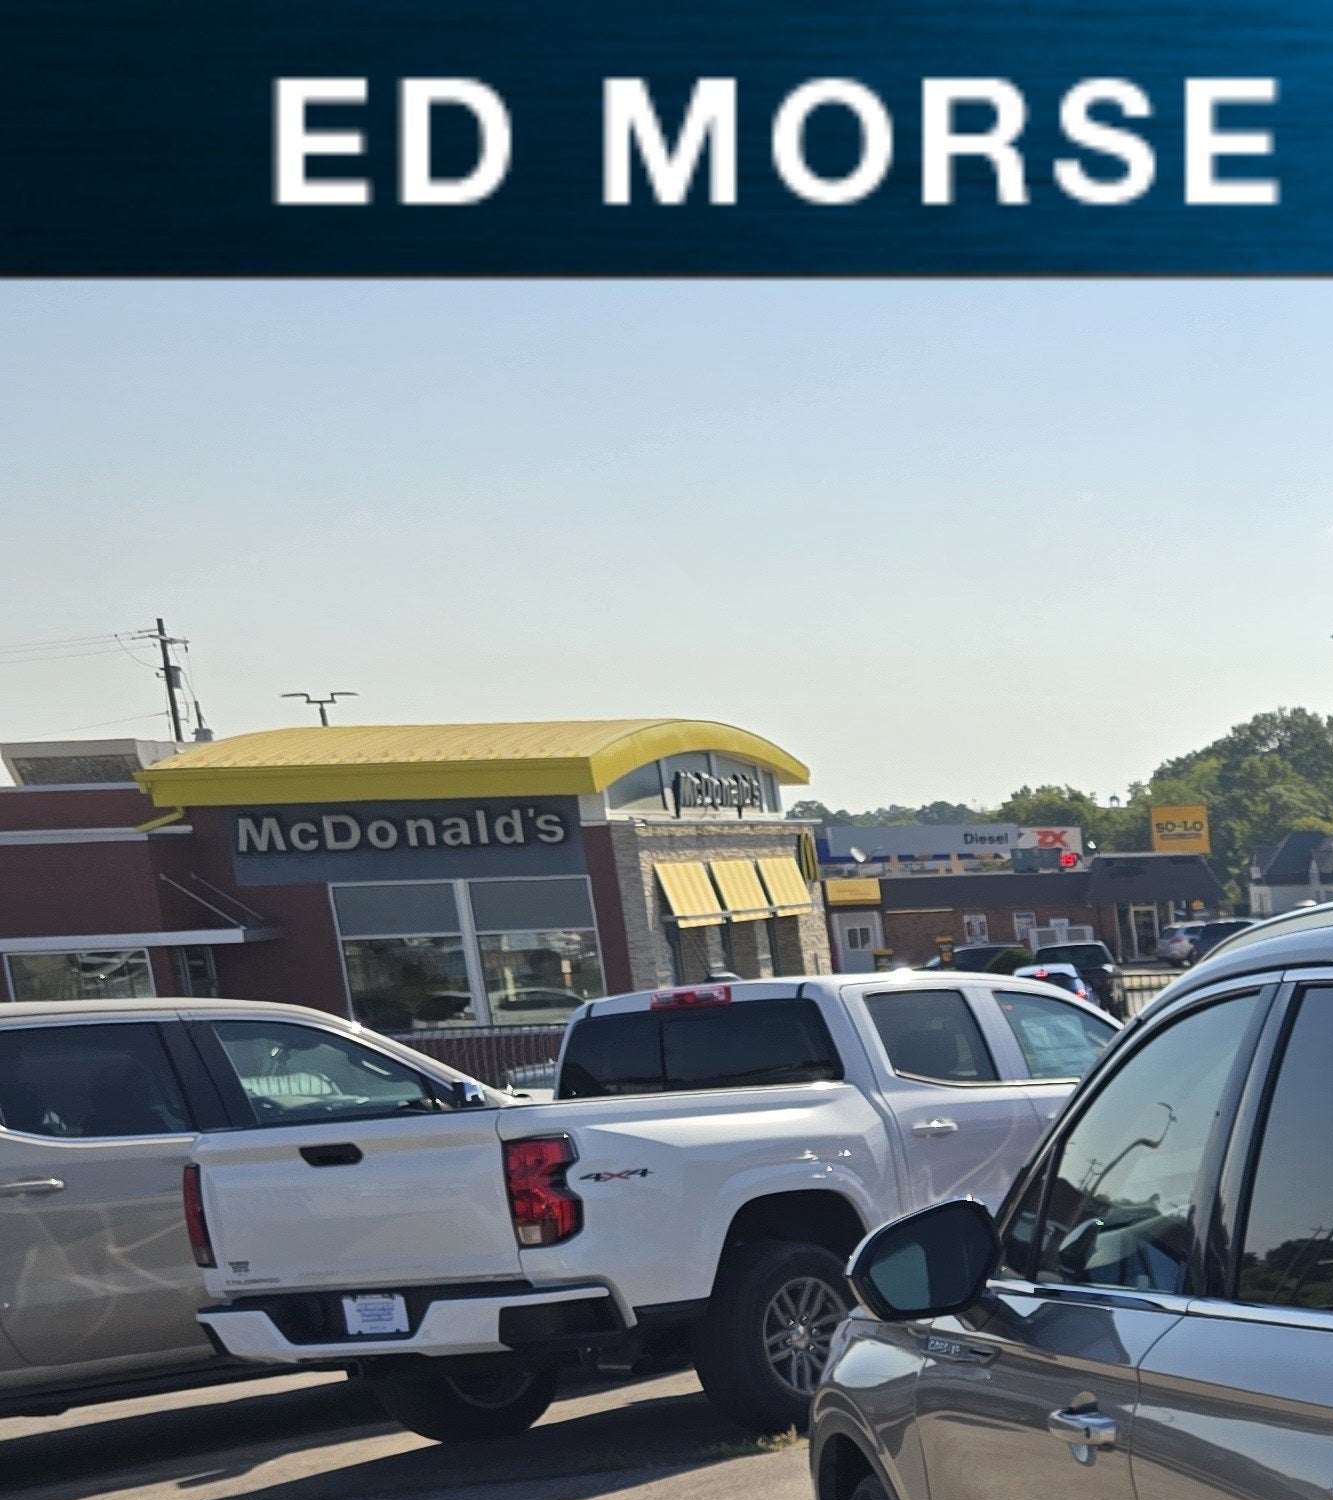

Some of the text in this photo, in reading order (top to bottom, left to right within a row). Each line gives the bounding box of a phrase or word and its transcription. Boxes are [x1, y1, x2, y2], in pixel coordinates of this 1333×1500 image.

[236, 807, 567, 854] McDonald's
[1155, 820, 1204, 834] SO-LO
[963, 832, 1009, 845] Diesel
